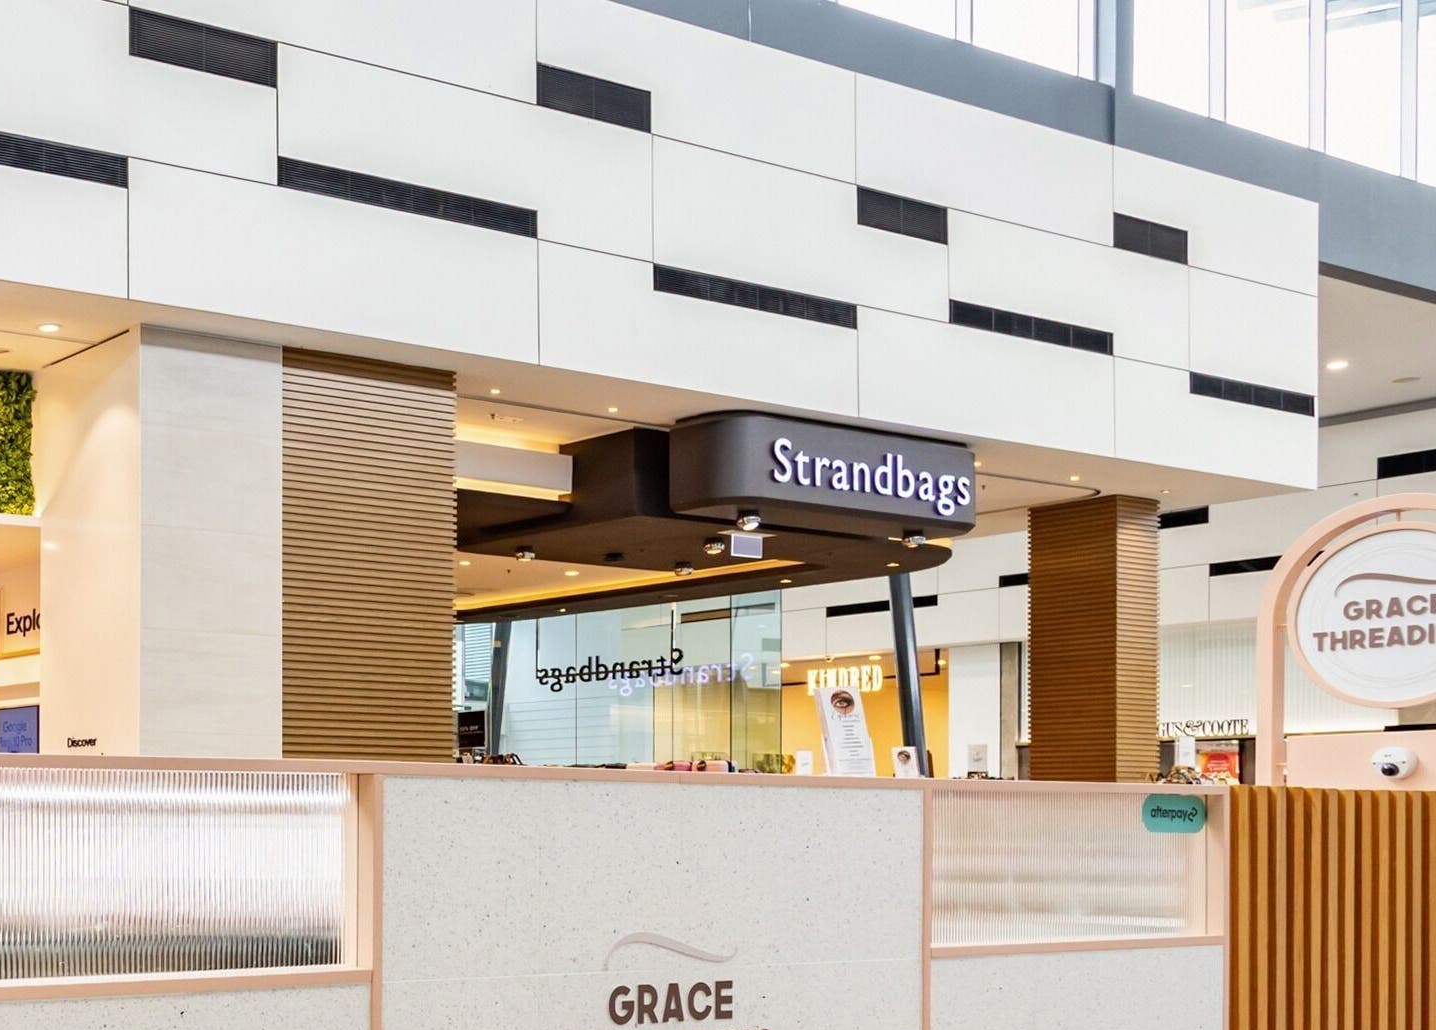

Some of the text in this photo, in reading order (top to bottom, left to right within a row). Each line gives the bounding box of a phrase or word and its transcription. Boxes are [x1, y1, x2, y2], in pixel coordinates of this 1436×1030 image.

[771, 437, 971, 516] Strandbags
[67, 737, 97, 748] Discover
[1150, 805, 1189, 822] afterpay
[607, 979, 733, 1025] GRACE
